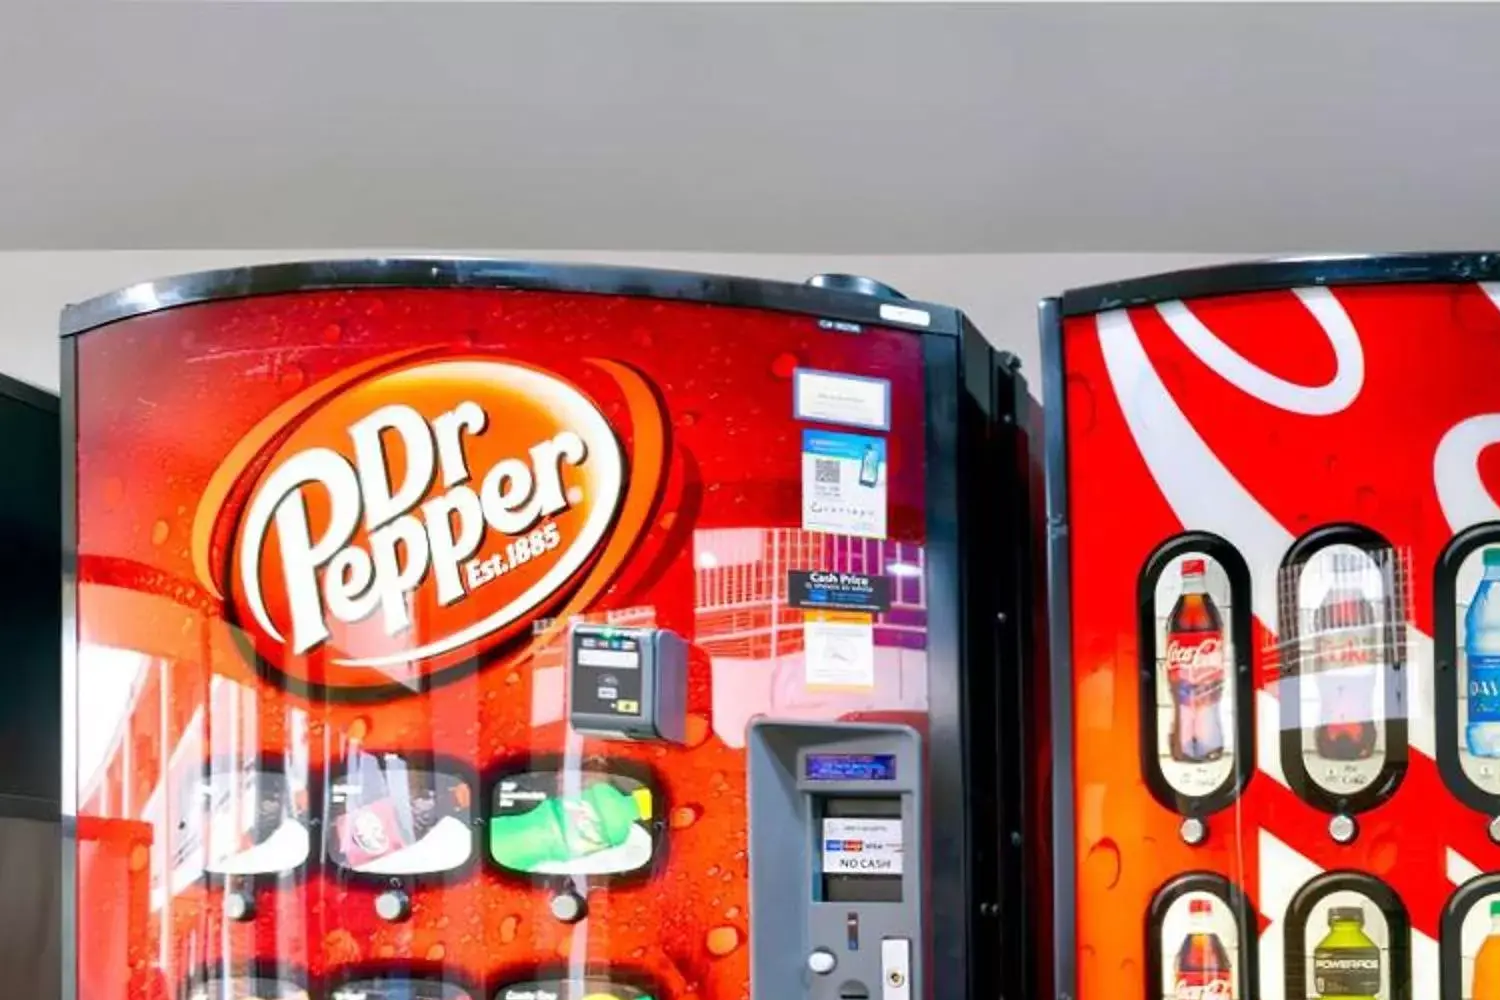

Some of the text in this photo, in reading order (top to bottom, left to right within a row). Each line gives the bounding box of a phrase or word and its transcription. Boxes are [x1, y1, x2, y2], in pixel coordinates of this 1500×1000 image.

[350, 401, 486, 528] Dr
[241, 431, 586, 655] Pepper
[809, 573, 869, 586] Cash Price
[841, 859, 891, 869] NO CASH
